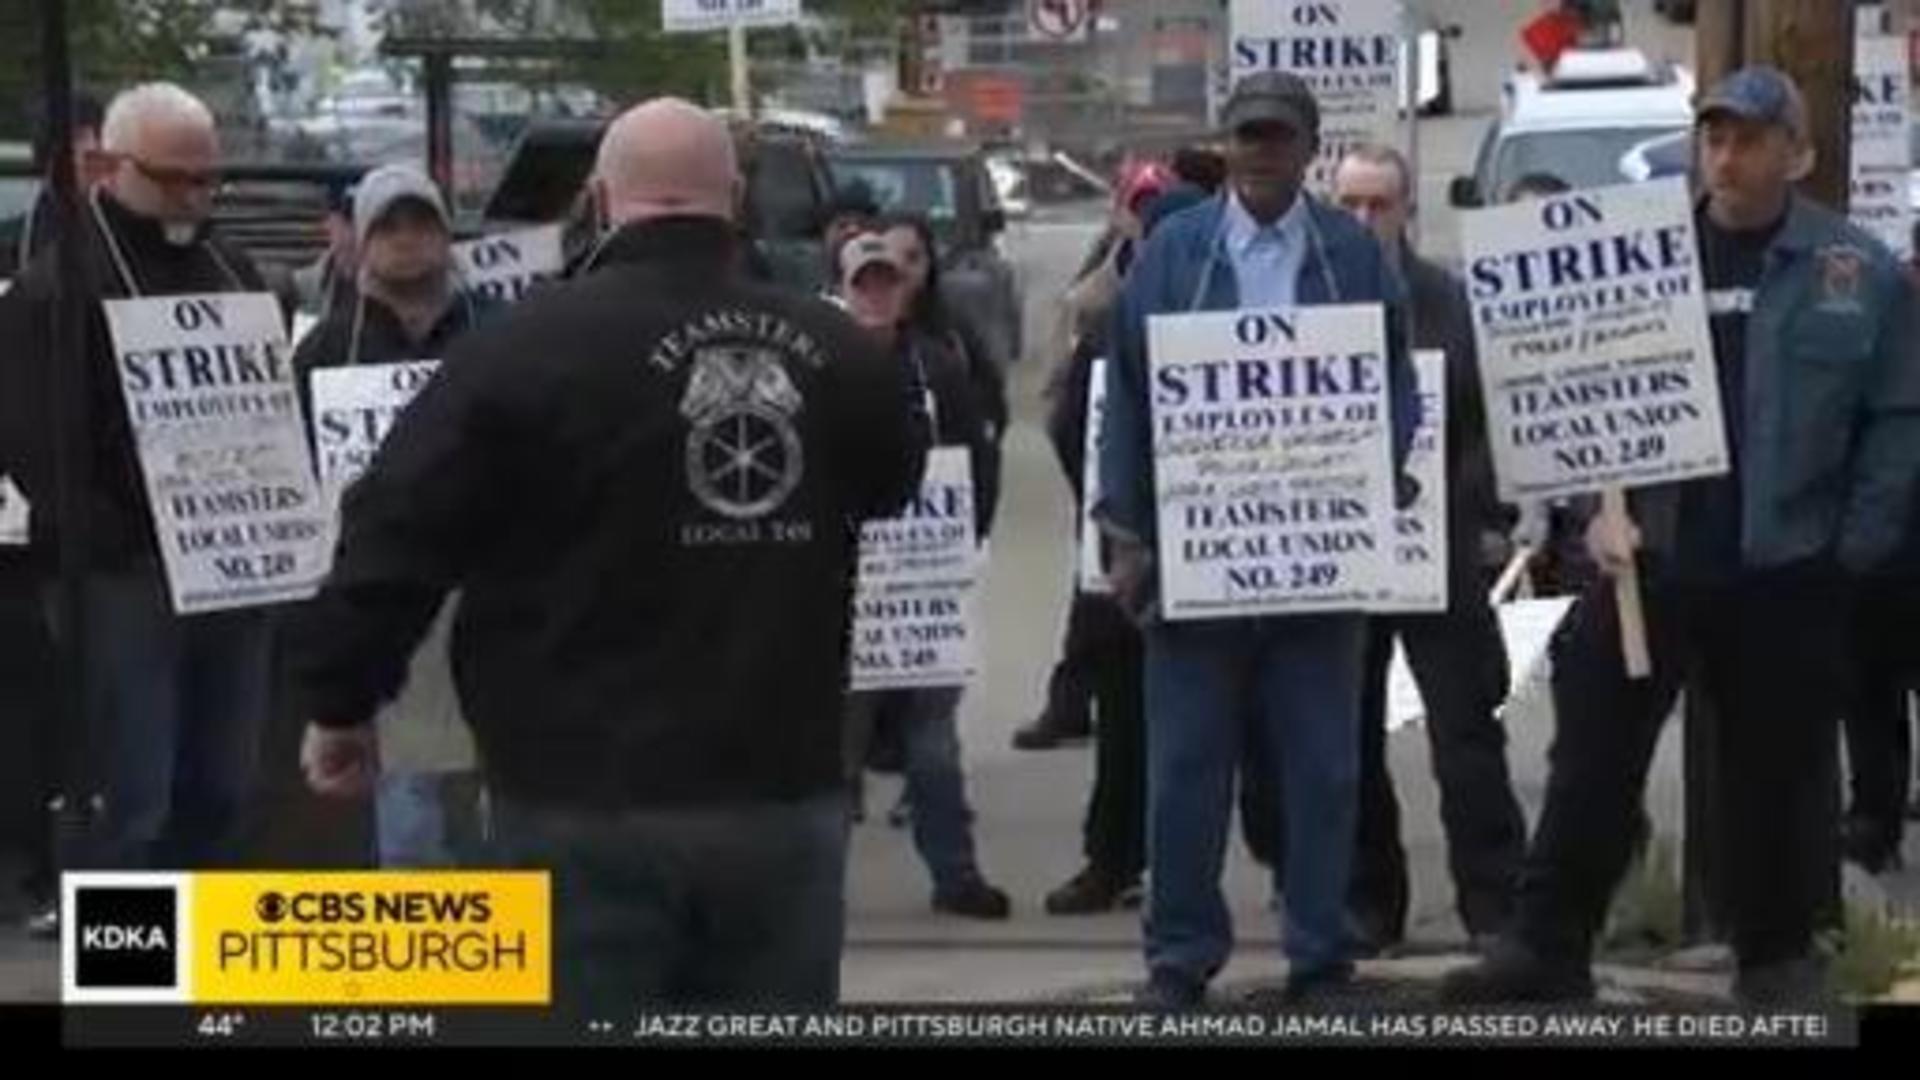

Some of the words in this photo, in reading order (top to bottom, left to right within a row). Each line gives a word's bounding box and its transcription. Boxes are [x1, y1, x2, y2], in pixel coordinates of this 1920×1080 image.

[1293, 4, 1338, 25] ON
[1236, 35, 1396, 69] STRIKE
[1543, 197, 1603, 231] ON
[473, 239, 521, 269] ON
[1472, 224, 1692, 299] STRIKE
[175, 299, 224, 331] ON
[1481, 283, 1649, 324] EMPLOYEES
[1657, 275, 1691, 299] OF
[651, 311, 828, 371] TEAMSTERS
[1236, 312, 1296, 344] ON
[124, 340, 288, 391] STRIKE
[1156, 352, 1381, 406] STRIKE
[1511, 371, 1690, 416] TEAMSTERS
[1163, 408, 1337, 433] EMPLOYEES
[1345, 403, 1379, 423] OF
[1512, 416, 1597, 447] LOCAL
[1604, 400, 1700, 435] UNION
[1618, 434, 1666, 464] 249
[1185, 498, 1368, 530] TEAMSTERS
[1184, 535, 1274, 562] LOCAL
[1279, 529, 1375, 555] UNION
[1290, 561, 1339, 589] 249
